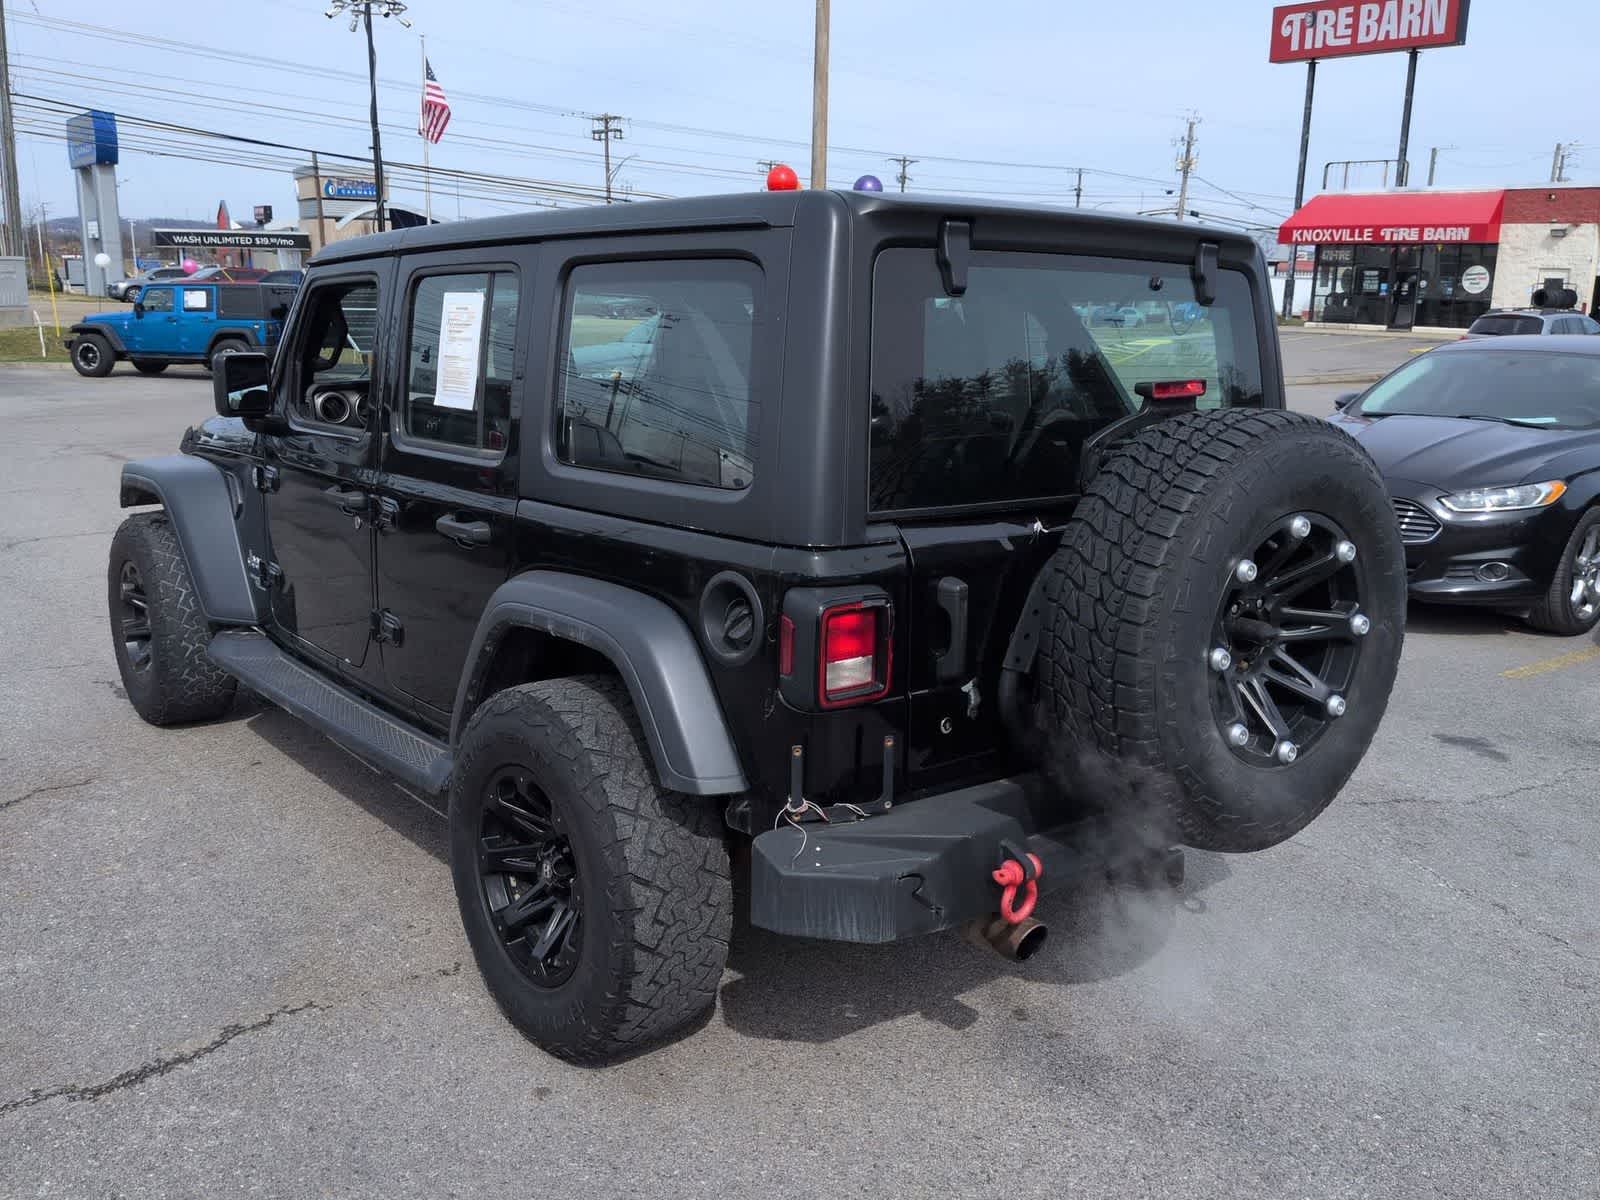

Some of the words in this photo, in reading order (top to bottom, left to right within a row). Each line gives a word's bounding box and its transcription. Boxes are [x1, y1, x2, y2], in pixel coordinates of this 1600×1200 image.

[1357, 0, 1449, 43] BARN
[172, 235, 201, 244] WASH
[203, 236, 253, 245] UNLIMITED
[1292, 228, 1374, 242] KNOXVILLE
[1423, 227, 1471, 241] BARN
